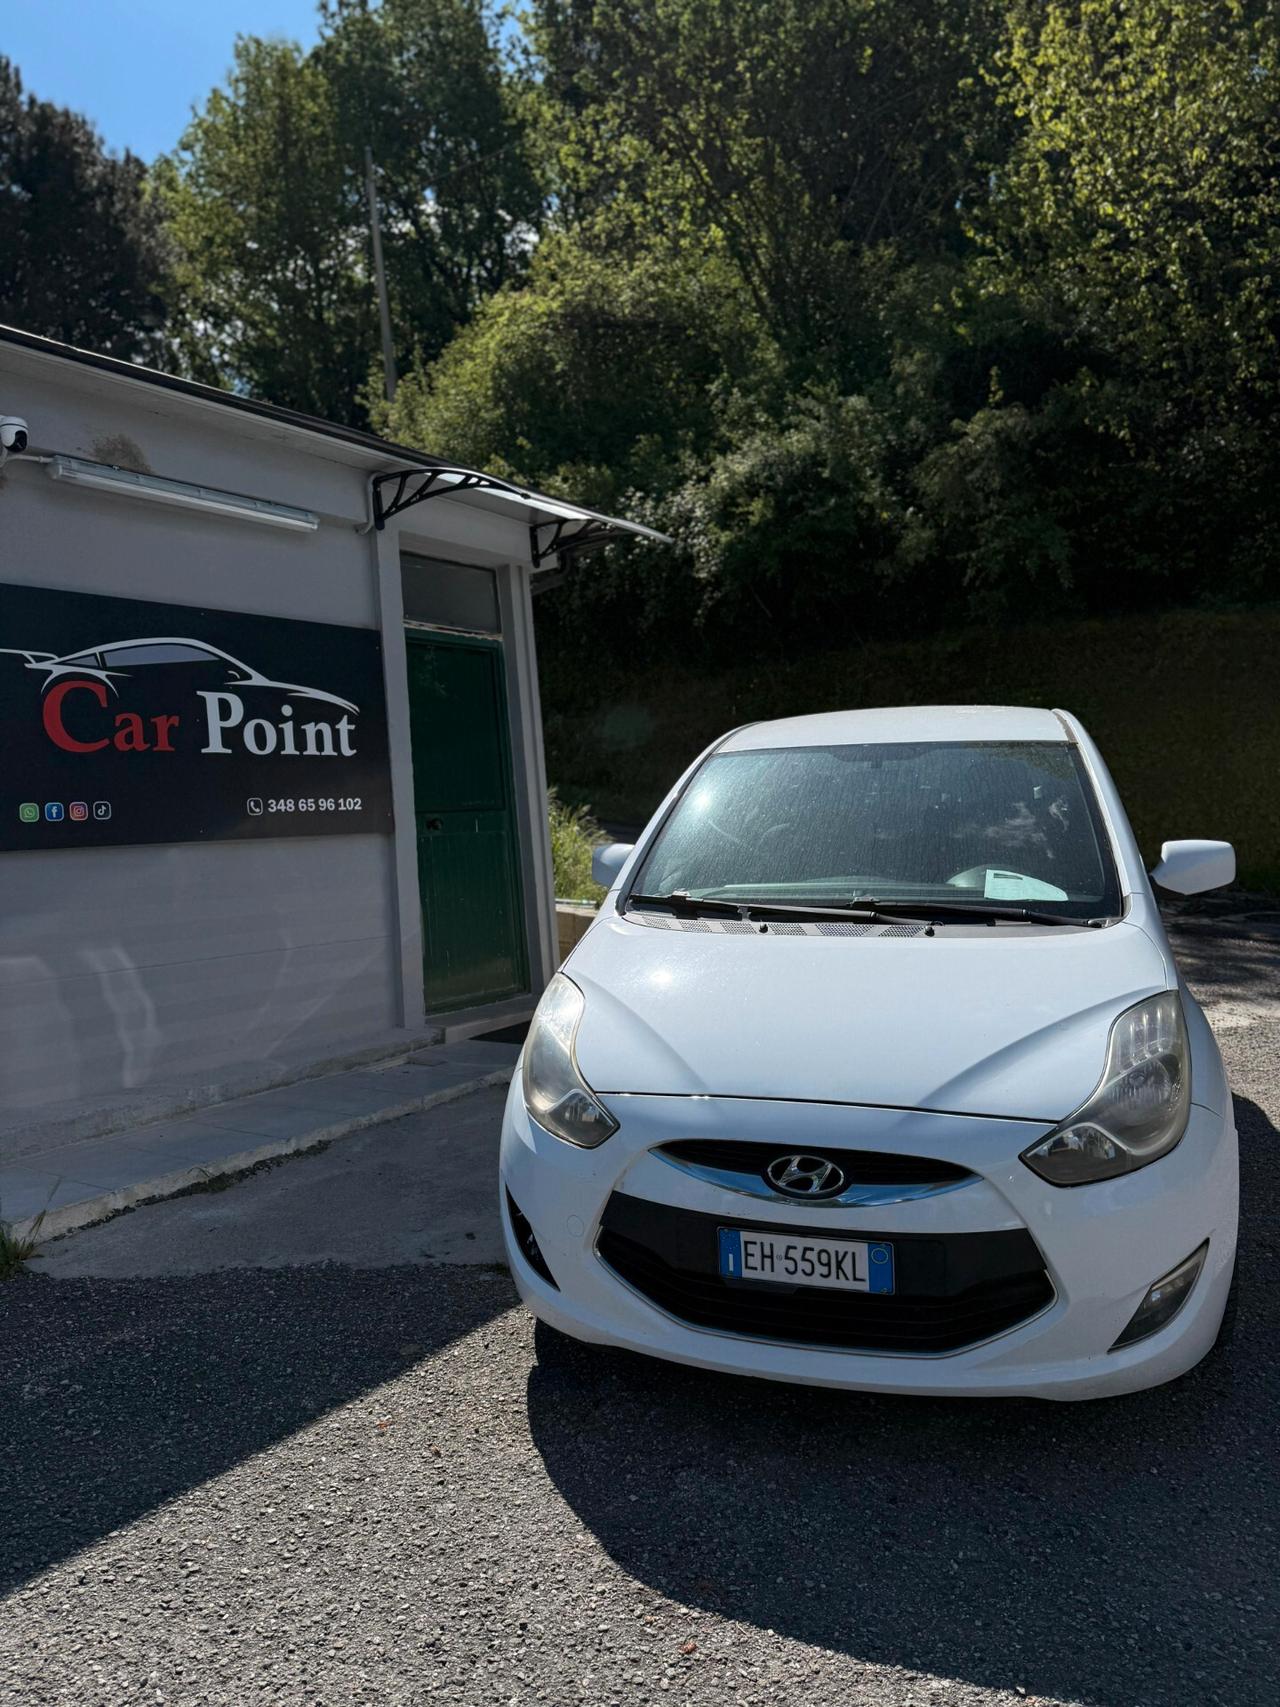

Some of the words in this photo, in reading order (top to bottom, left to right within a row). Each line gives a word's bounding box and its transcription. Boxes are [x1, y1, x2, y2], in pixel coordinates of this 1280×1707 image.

[43, 680, 180, 754] Car
[196, 690, 357, 756] Point
[268, 799, 295, 812] 348
[298, 798, 316, 811] 65
[318, 798, 335, 811] 96
[338, 797, 362, 810] 102
[743, 1240, 775, 1273] EH
[784, 1245, 866, 1282] 559KL
